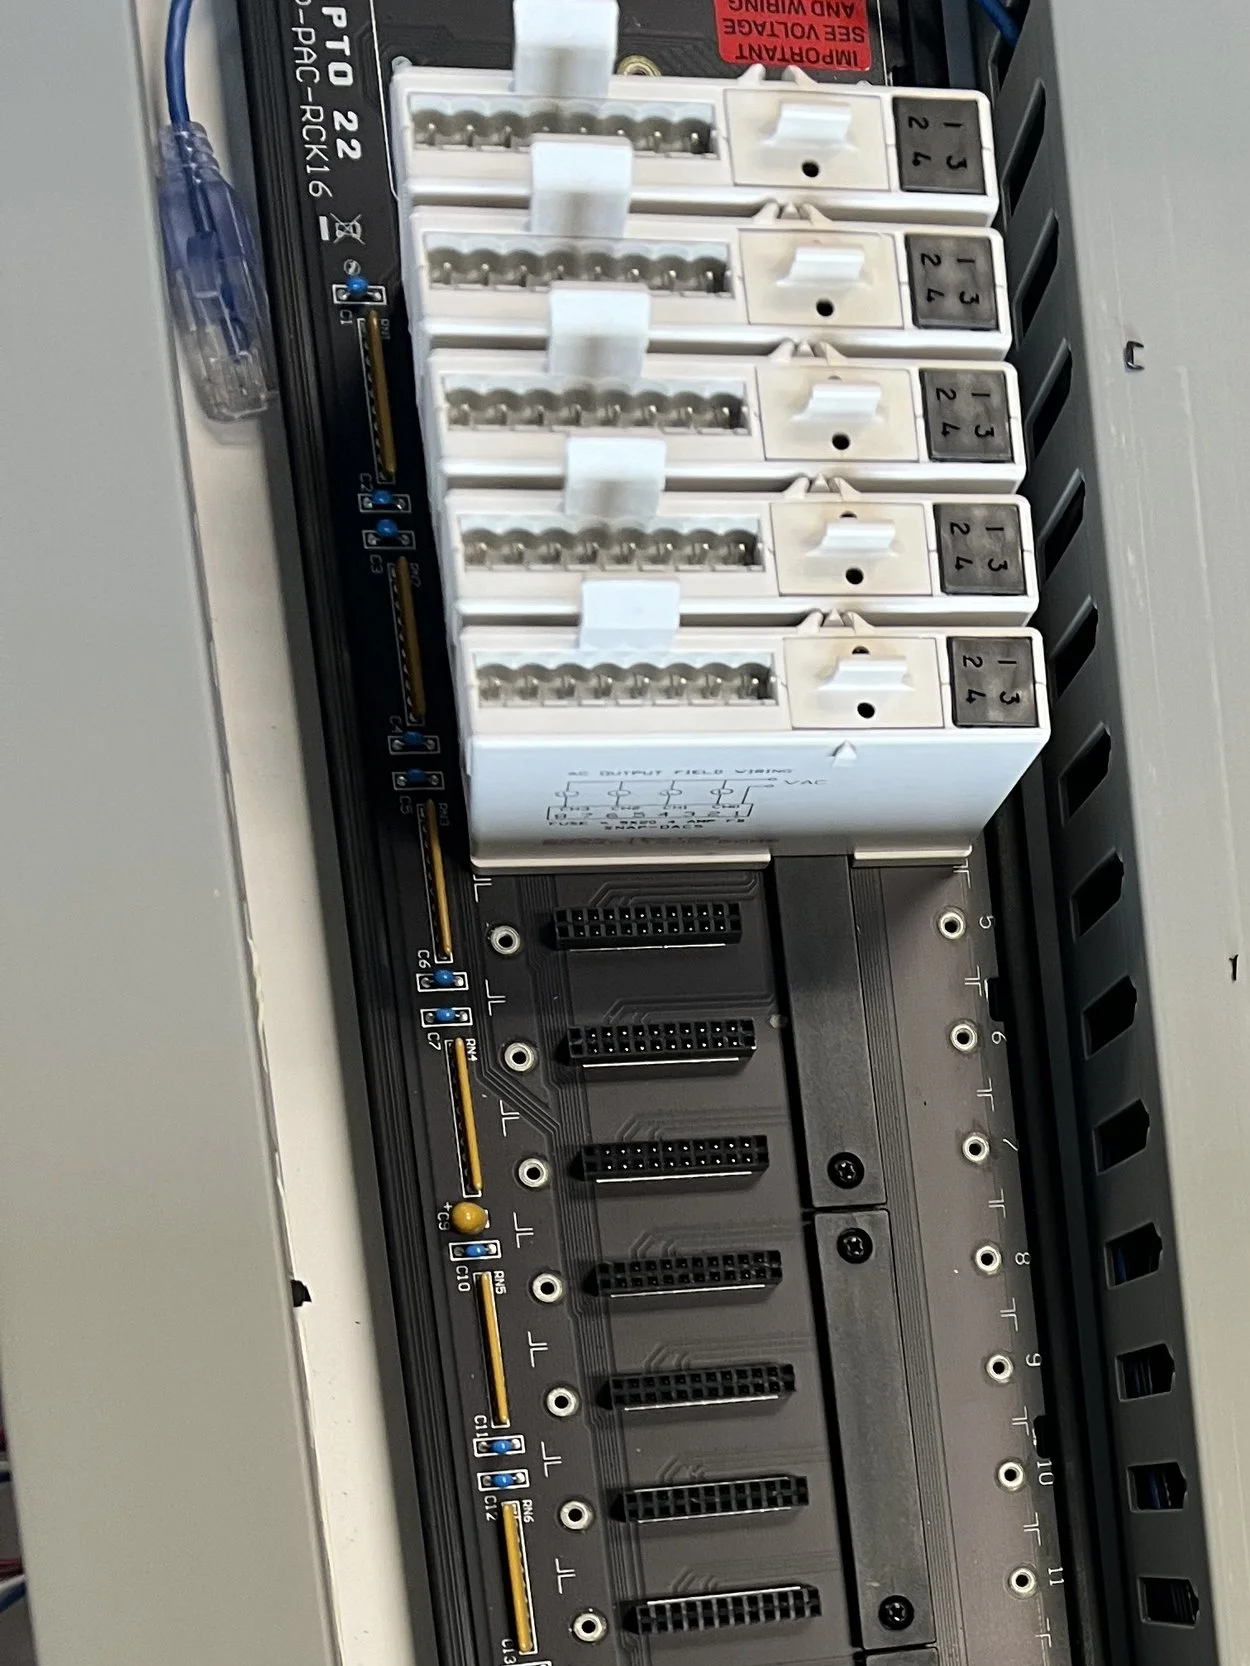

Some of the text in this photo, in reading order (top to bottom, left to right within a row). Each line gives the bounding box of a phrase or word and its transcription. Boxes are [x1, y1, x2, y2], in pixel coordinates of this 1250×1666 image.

[811, 0, 854, 18] AND
[723, 18, 865, 43] SEE VOLTAGE
[735, 43, 858, 66] IMPORTANT
[291, 0, 333, 198] -PAC-RCK16
[907, 116, 930, 130] 2
[333, 110, 362, 160] 22
[946, 155, 967, 170] 3
[920, 253, 945, 303] 2 4
[959, 290, 980, 305] 3
[936, 387, 961, 437] 2 4
[974, 424, 995, 439] 3
[359, 472, 373, 493] C2
[950, 521, 974, 571] 2 4
[370, 554, 384, 575] C3
[987, 557, 1009, 572] 3
[962, 655, 986, 704] 2 4
[999, 690, 1021, 705] 3
[979, 914, 996, 930] 5
[417, 949, 431, 969] C6
[427, 1031, 442, 1051] C7
[991, 1029, 1007, 1045] 6
[464, 1037, 478, 1062] RN4
[437, 1211, 450, 1231] C9
[1015, 1251, 1030, 1265] 8
[455, 1265, 470, 1292] C10
[493, 1270, 507, 1295] RN5
[1025, 1352, 1042, 1367] 9
[1036, 1459, 1054, 1486] 10
[484, 1495, 498, 1522] C12
[521, 1499, 535, 1524] RN6
[1047, 1566, 1064, 1586] 11
[501, 1639, 516, 1665] C13
